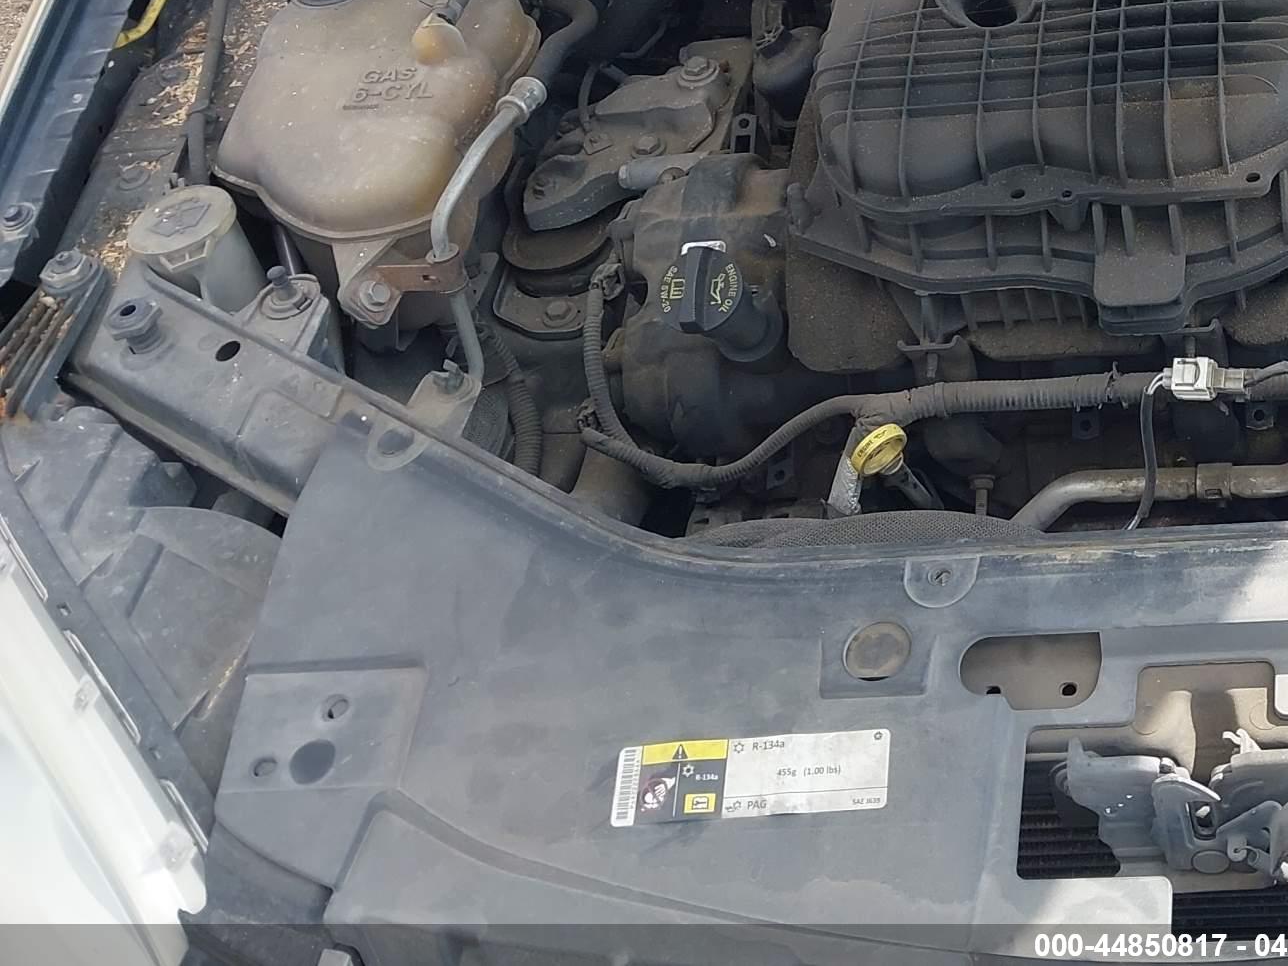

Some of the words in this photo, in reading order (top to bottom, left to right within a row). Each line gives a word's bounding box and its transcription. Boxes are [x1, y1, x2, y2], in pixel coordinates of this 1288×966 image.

[664, 265, 678, 284] SAE
[725, 263, 738, 297] ENGINE
[718, 298, 733, 313] OIL
[752, 740, 785, 751] R-134a
[776, 767, 797, 777] 455g
[747, 799, 768, 810] PAG
